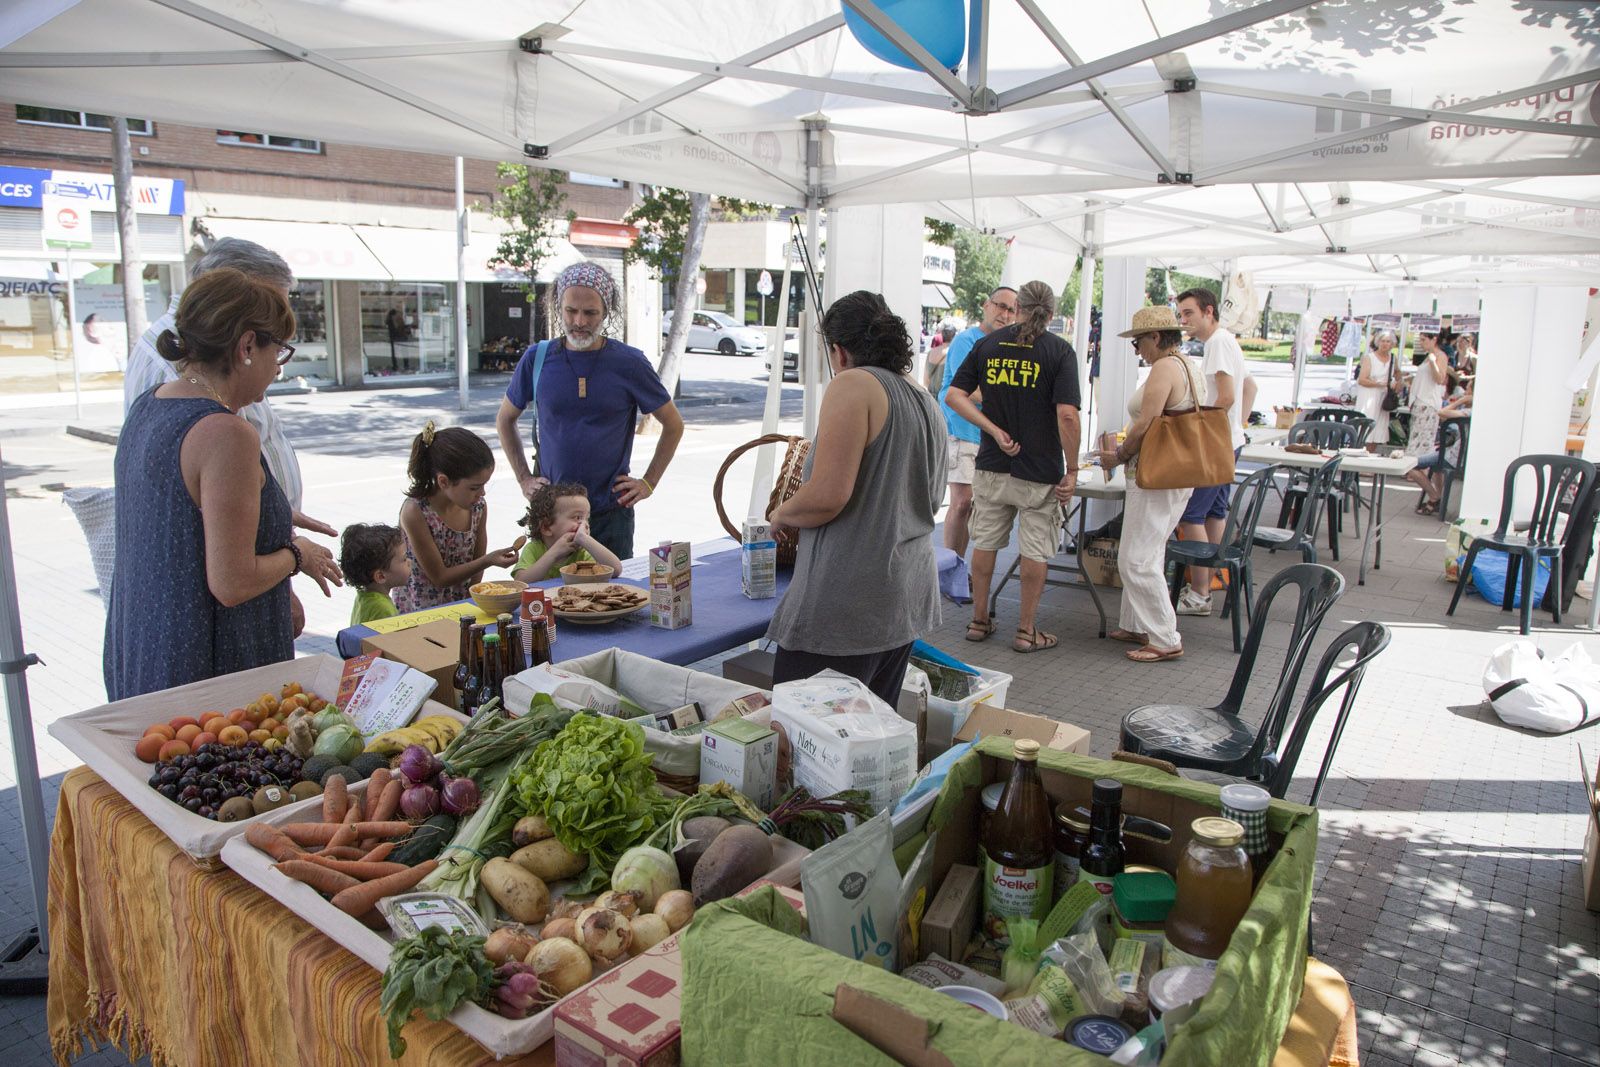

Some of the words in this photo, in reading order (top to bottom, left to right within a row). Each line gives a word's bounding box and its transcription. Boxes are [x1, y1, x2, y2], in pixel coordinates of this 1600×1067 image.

[0, 183, 33, 198] CES
[987, 358, 1000, 368] HE
[1002, 358, 1020, 369] FET
[1021, 360, 1033, 370] EL
[986, 362, 1040, 388] SALT!
